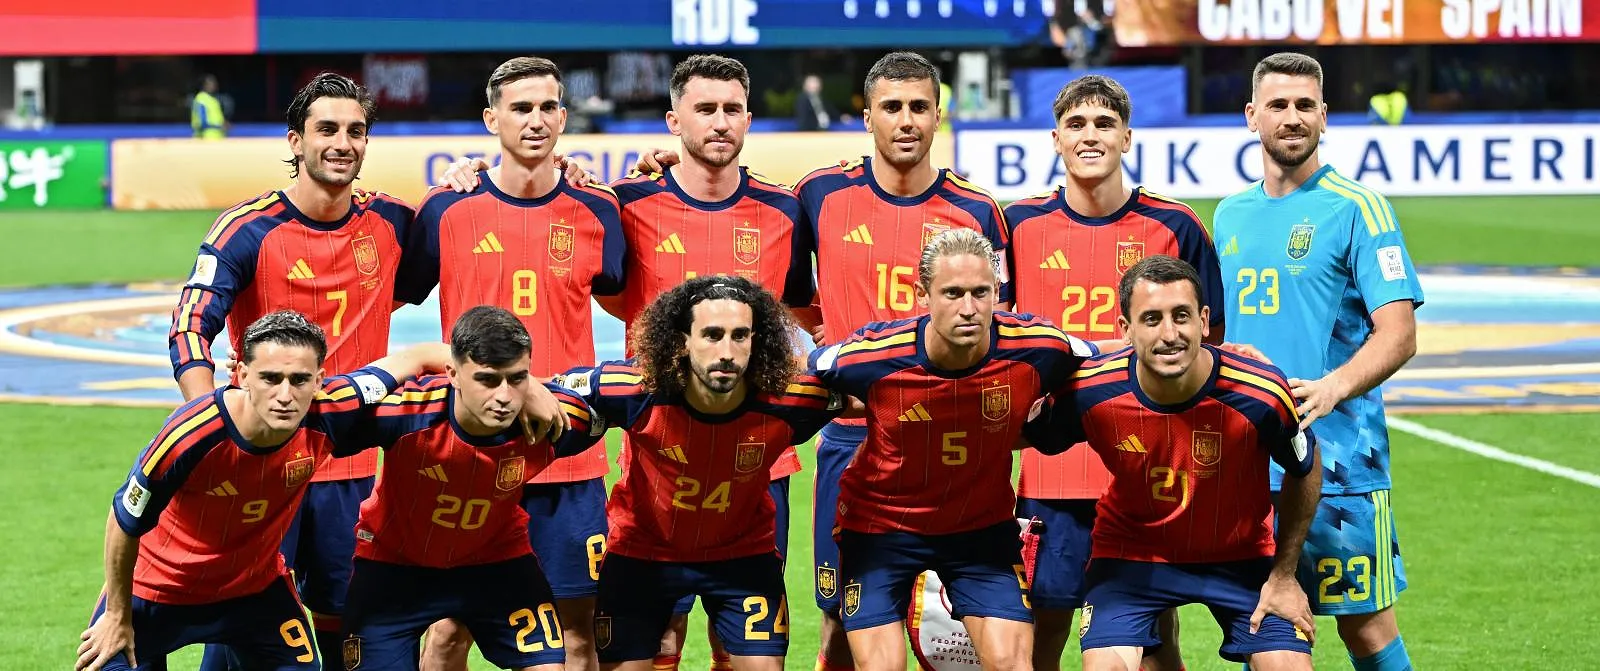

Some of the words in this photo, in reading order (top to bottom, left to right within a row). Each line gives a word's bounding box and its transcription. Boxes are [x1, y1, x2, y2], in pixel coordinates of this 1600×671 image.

[1441, 0, 1582, 38] SPAIN
[996, 141, 1200, 187] BNK
[512, 269, 537, 316] 8
[876, 263, 914, 312] 16
[1062, 286, 1115, 332] 22
[1237, 268, 1280, 315] 23
[326, 290, 348, 337] 7
[941, 431, 968, 466] 5
[672, 476, 731, 513] 24
[1150, 466, 1188, 510] 21
[241, 499, 268, 523] 9
[431, 494, 491, 530] 20
[1317, 555, 1371, 604] 23
[280, 618, 314, 663] 9
[509, 602, 564, 653] 20
[743, 596, 789, 641] 24
